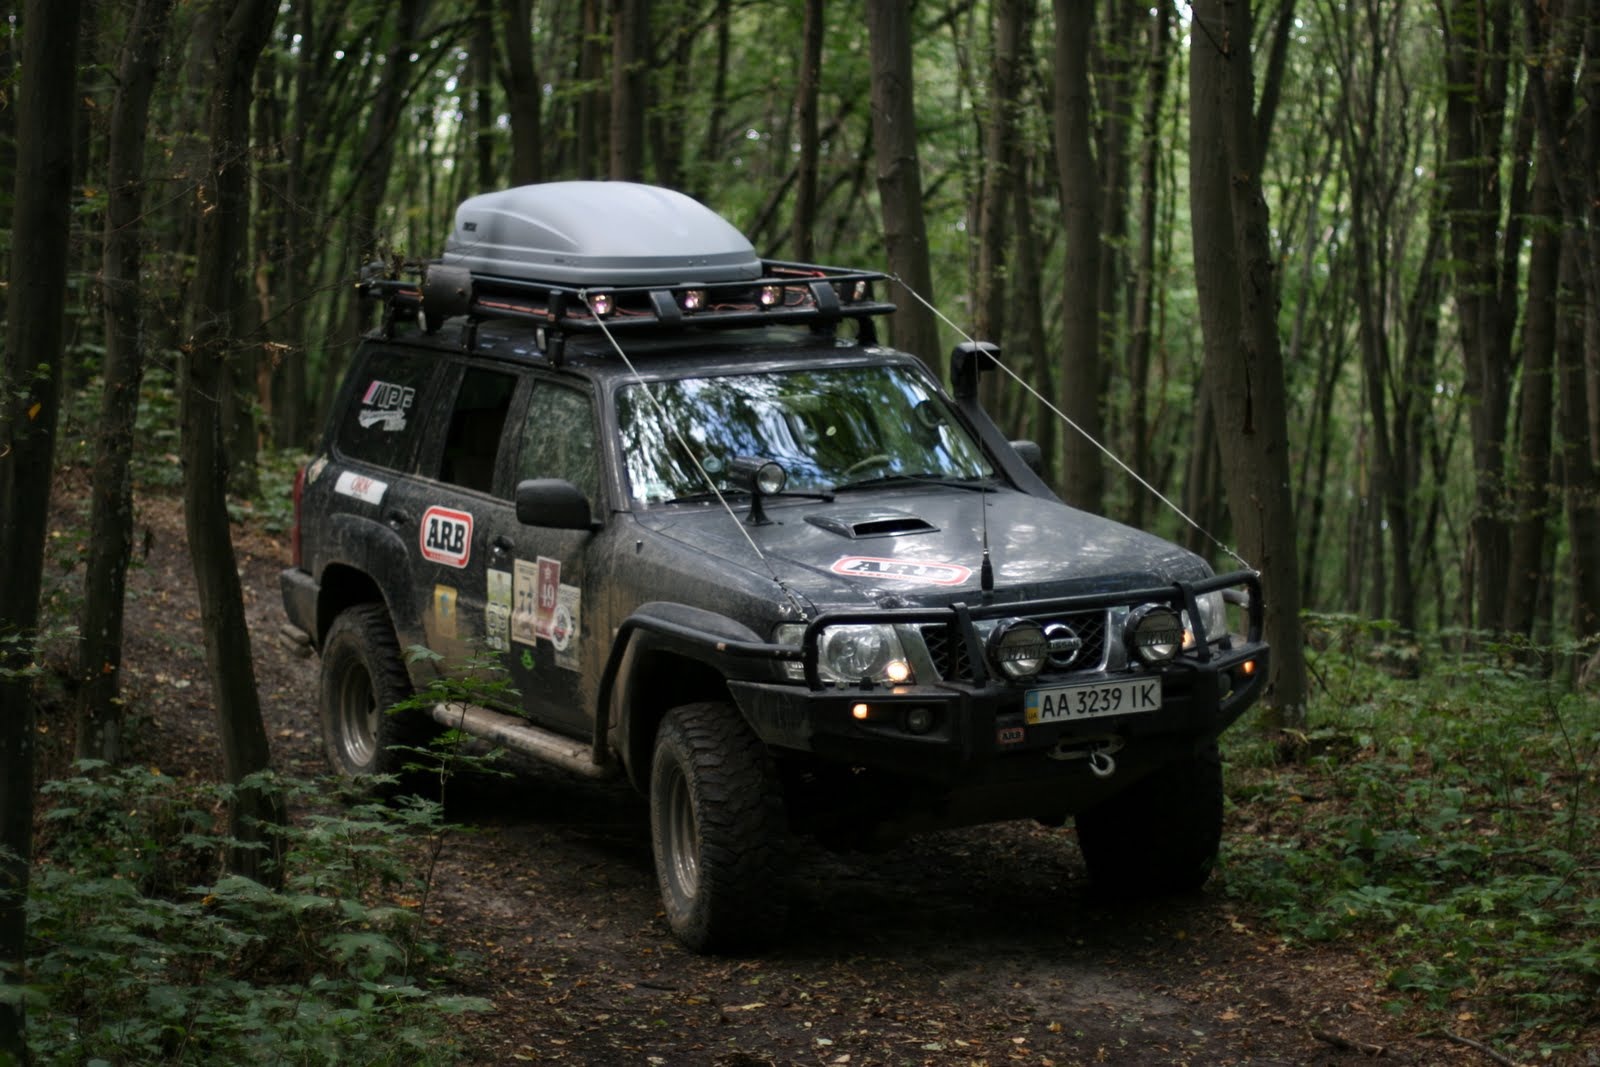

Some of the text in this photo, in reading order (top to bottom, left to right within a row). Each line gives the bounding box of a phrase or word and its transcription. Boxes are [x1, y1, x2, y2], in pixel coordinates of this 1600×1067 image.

[427, 518, 466, 554] ARB
[846, 560, 954, 580] ARB
[1042, 684, 1156, 718] AA 3239 IK
[1003, 731, 1021, 741] ARB
